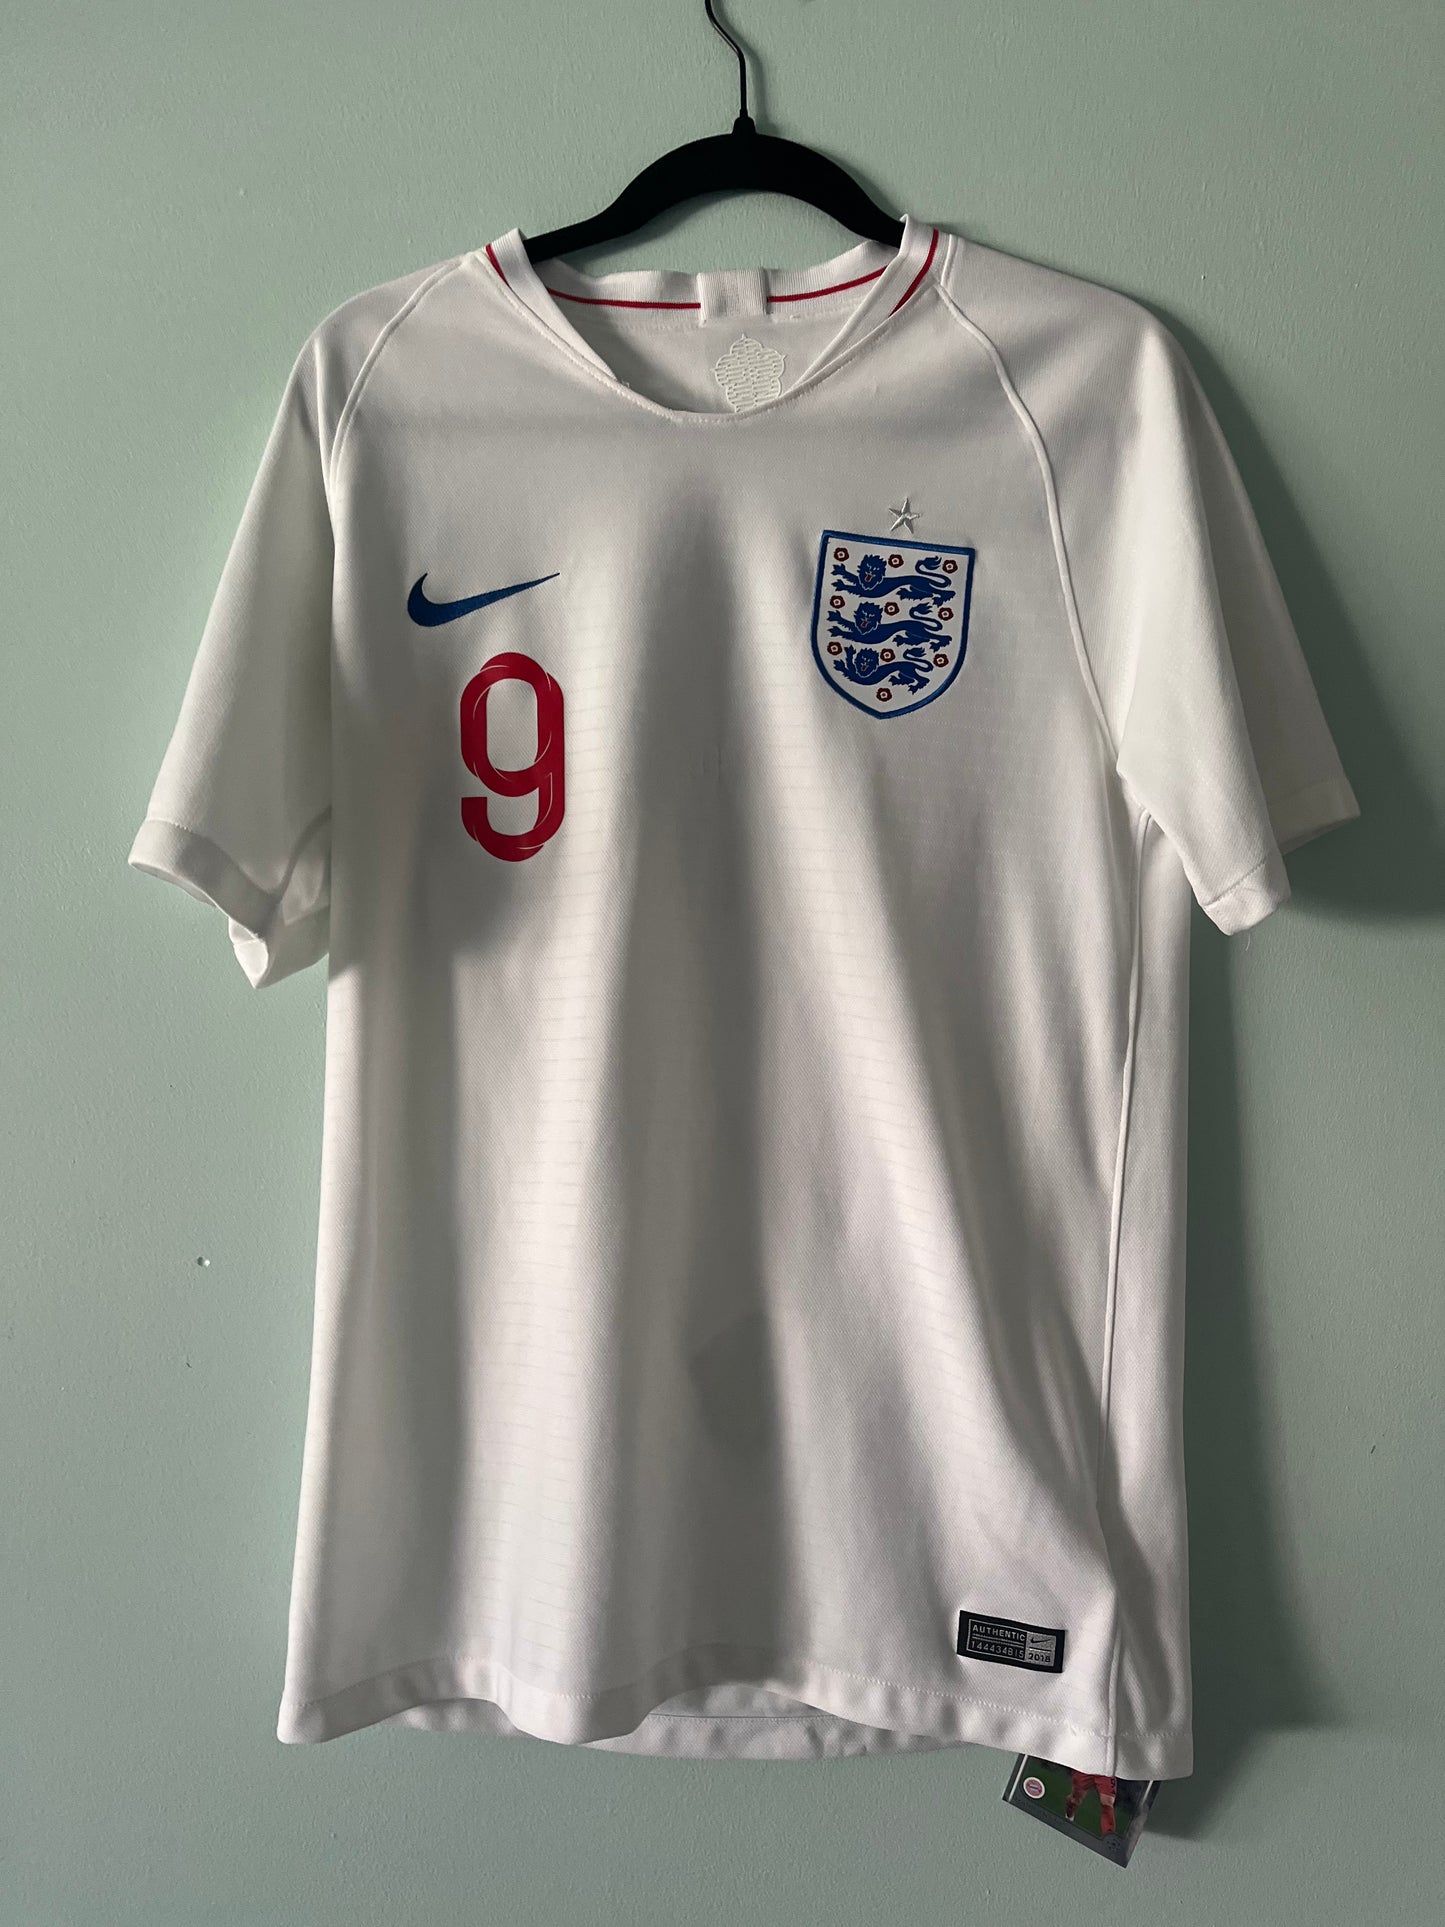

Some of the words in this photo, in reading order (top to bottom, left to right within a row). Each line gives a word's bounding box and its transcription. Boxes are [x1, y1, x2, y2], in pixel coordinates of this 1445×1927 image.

[460, 652, 565, 862] 9
[972, 1624, 1026, 1641] AUTHENTIC
[1028, 1652, 1051, 1663] 2018
